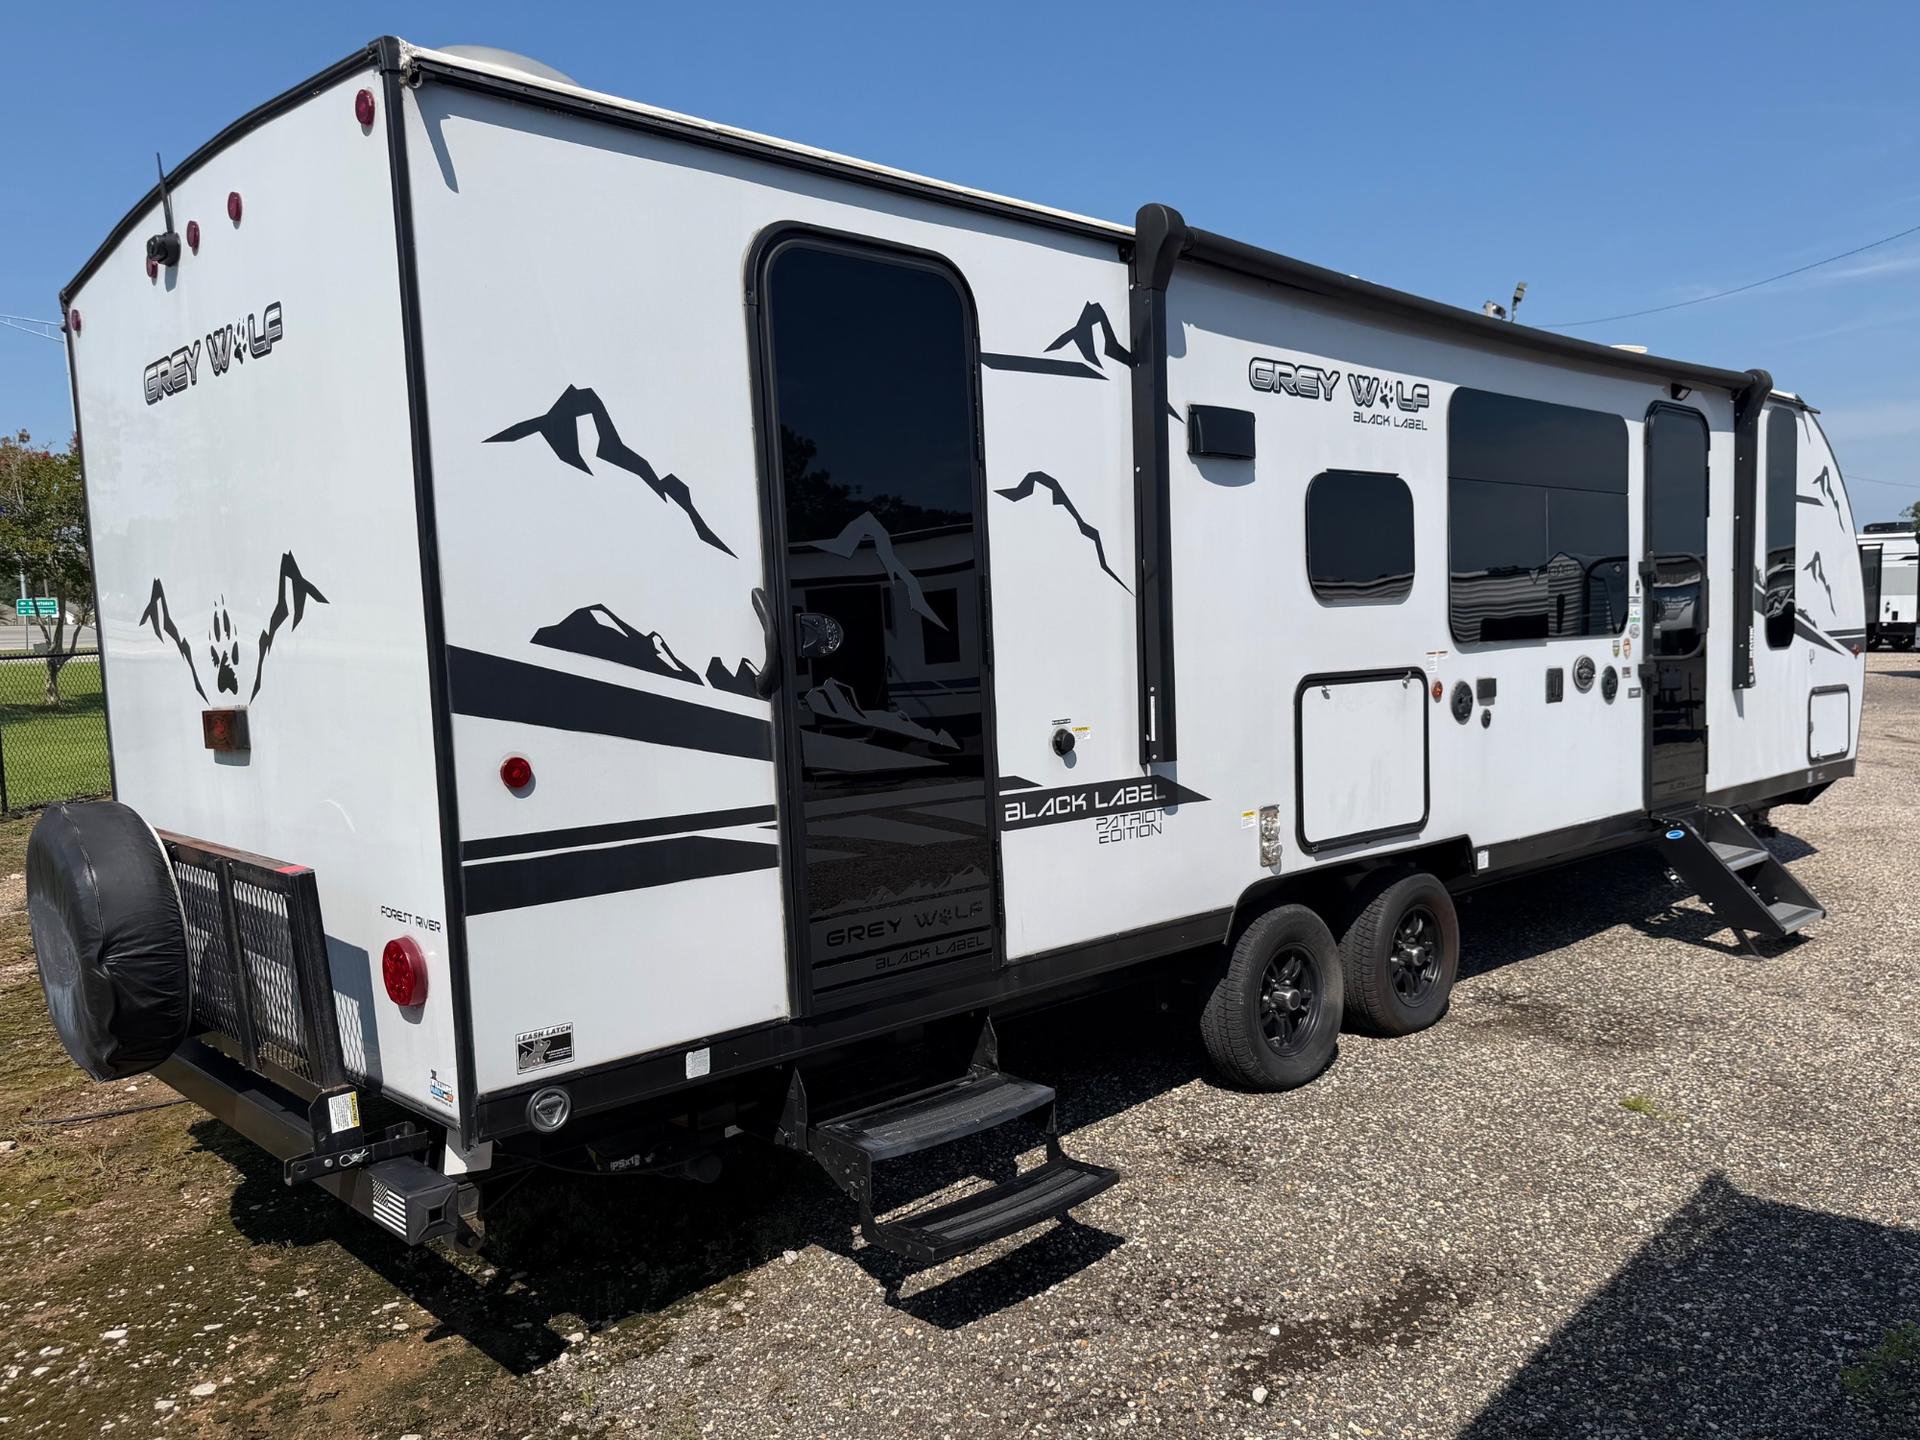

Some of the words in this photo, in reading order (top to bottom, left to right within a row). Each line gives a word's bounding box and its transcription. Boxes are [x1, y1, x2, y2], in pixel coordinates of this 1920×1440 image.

[144, 339, 201, 406] GREY
[1249, 357, 1340, 401] GREY
[1353, 411, 1390, 427] BLACK
[1394, 416, 1428, 431] LABEL
[1004, 793, 1087, 822] BLACK
[1095, 783, 1166, 810] LABEL
[1096, 808, 1165, 831] PATRIOT
[1098, 825, 1163, 844] EDITION
[381, 905, 412, 925] FOREST
[415, 915, 442, 933] RIVER
[826, 917, 902, 948] GREY
[875, 947, 930, 970] BLACK
[935, 935, 985, 957] LABEL
[518, 1031, 544, 1042] LEASH
[546, 1024, 572, 1036] LATCH
